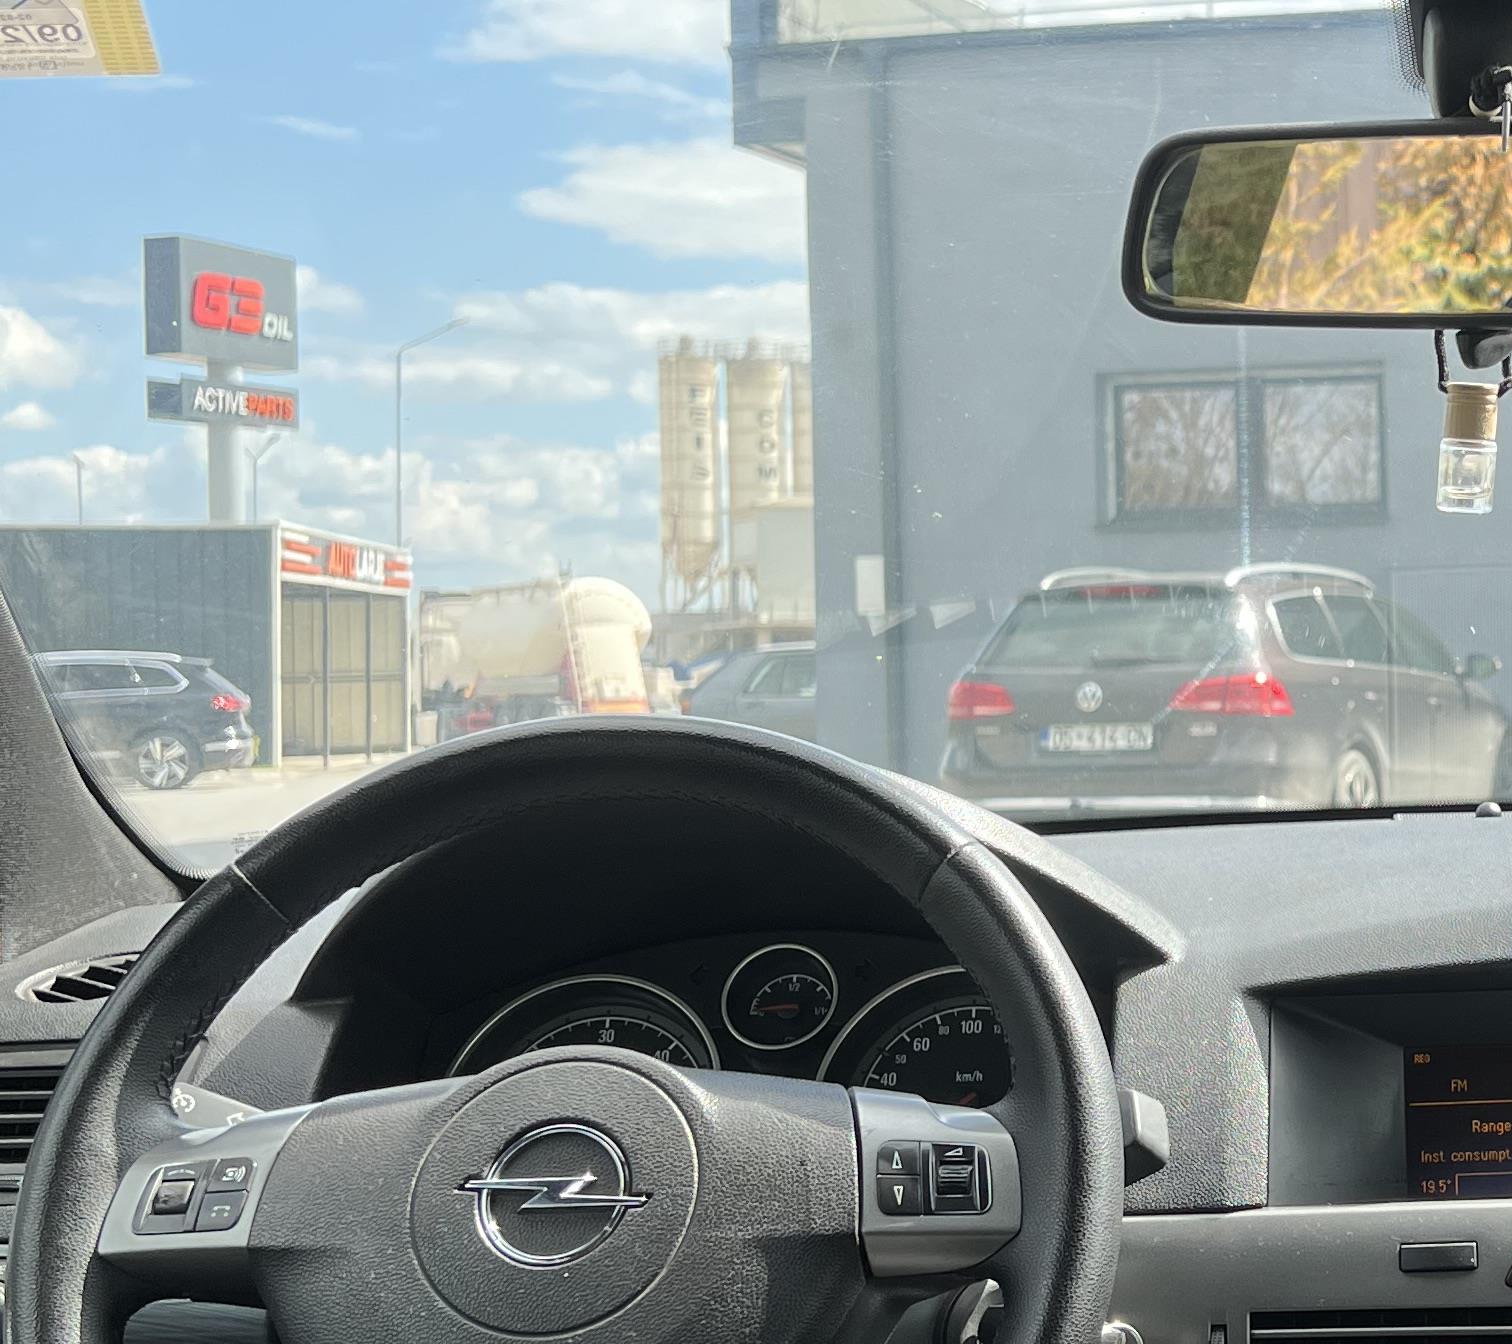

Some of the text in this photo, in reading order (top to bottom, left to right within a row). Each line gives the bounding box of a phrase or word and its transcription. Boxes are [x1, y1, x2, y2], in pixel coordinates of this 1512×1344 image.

[262, 311, 294, 342] OIL
[938, 1025, 950, 1036] 80
[960, 1019, 982, 1035] 100
[598, 1029, 615, 1043] 30
[913, 1037, 931, 1052] 60
[895, 1054, 907, 1065] 50
[880, 1071, 897, 1087] 40
[955, 1070, 983, 1083] km/h
[1451, 1078, 1468, 1093] FM
[1471, 1119, 1512, 1135] Range
[1421, 1149, 1445, 1163] Inst
[1450, 1147, 1512, 1163] consumpt
